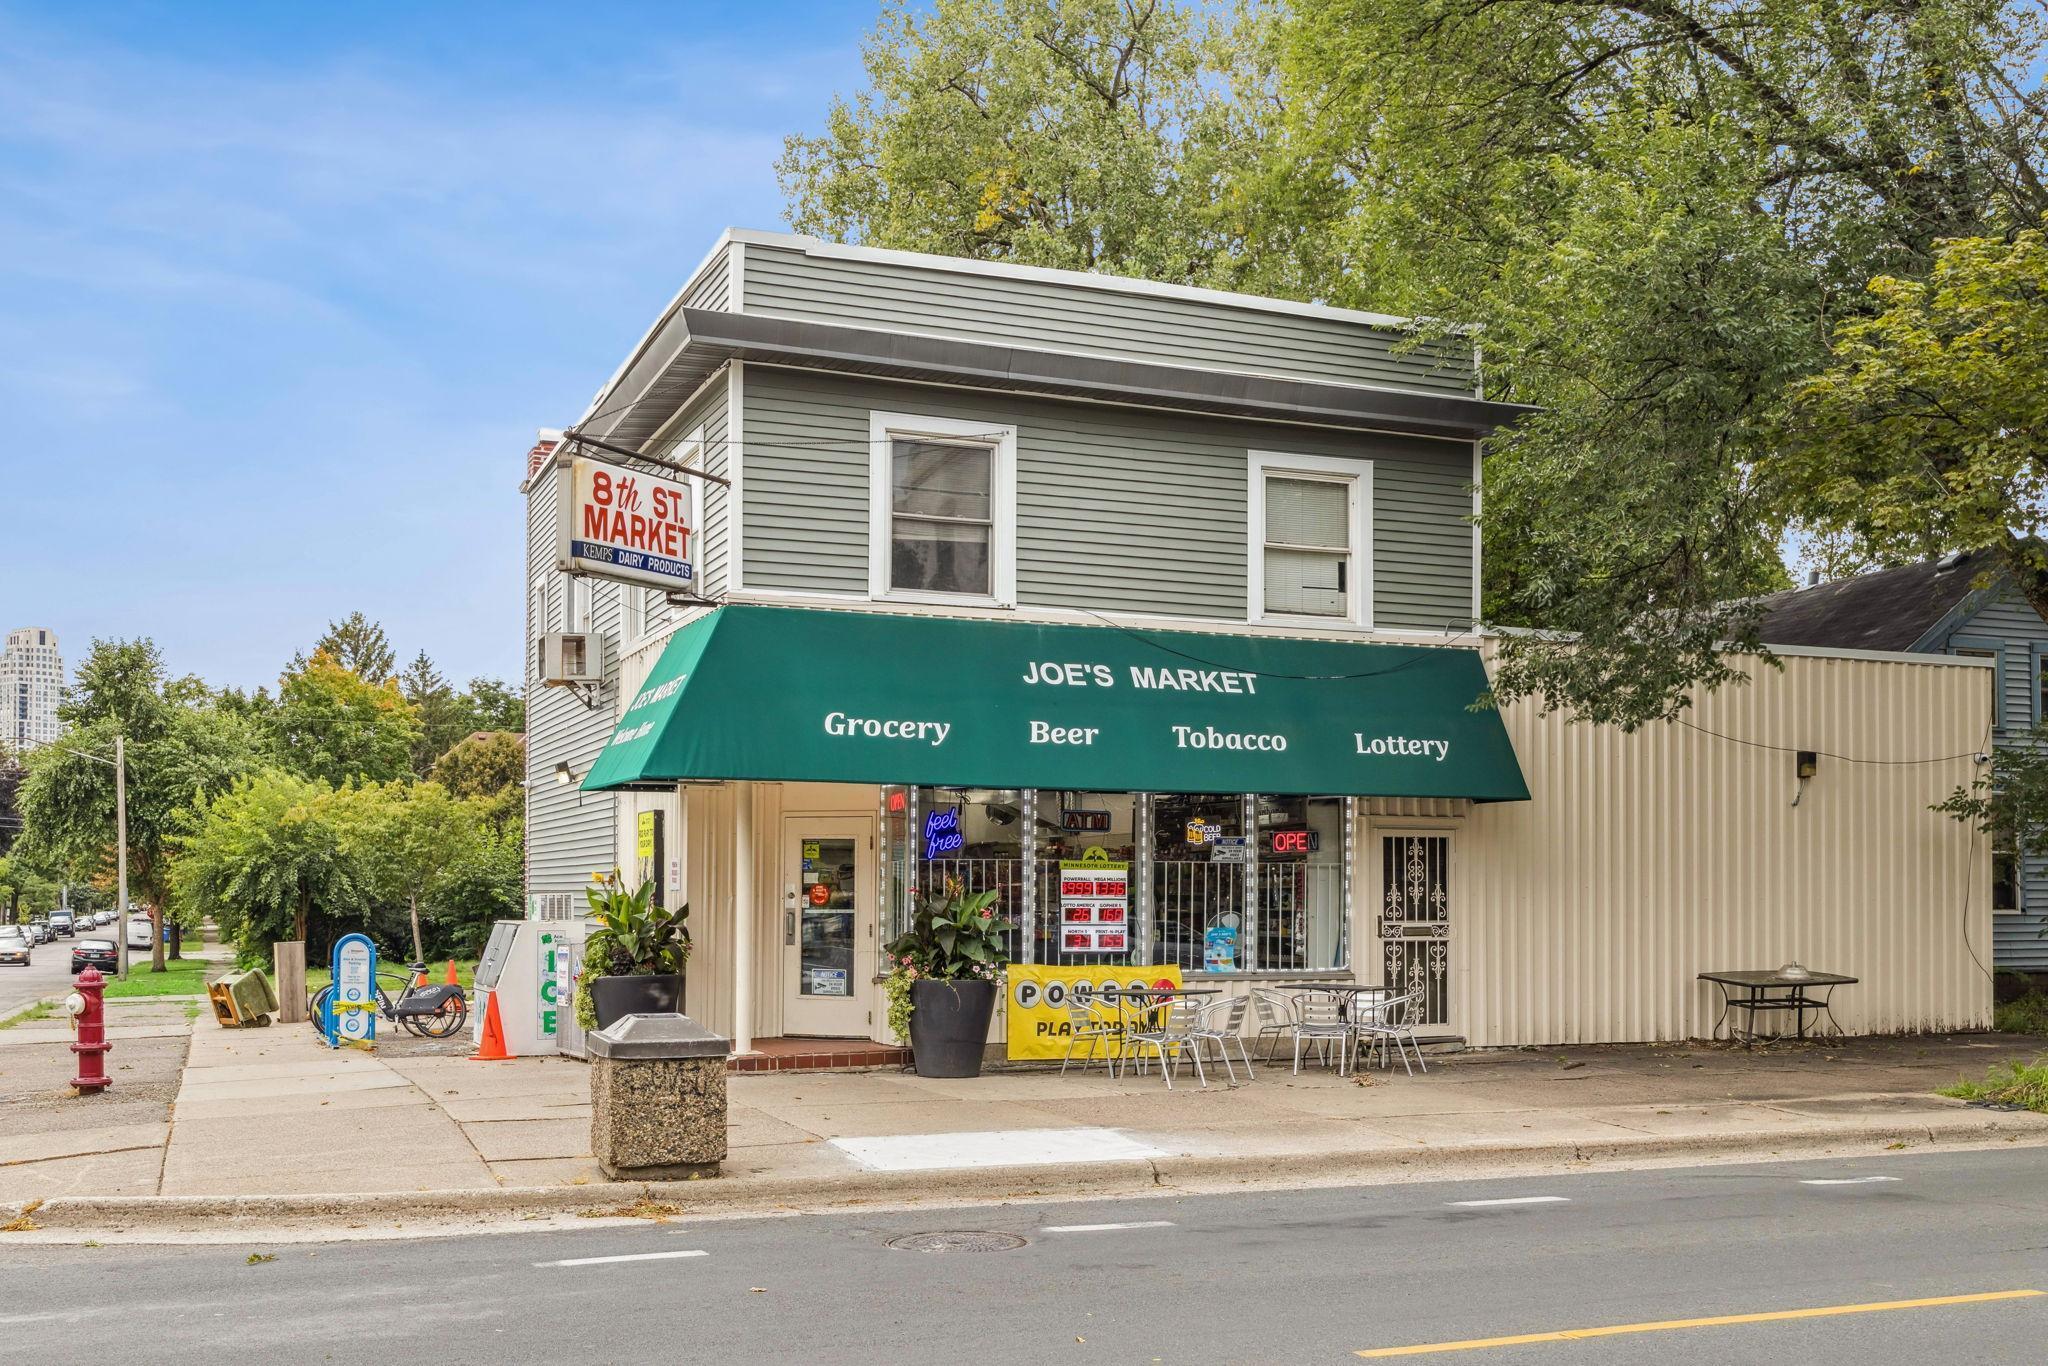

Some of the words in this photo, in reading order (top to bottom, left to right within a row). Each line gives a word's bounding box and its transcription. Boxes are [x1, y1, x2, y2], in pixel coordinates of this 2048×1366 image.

[592, 470, 642, 512] 8th
[652, 486, 685, 525] ST.
[584, 503, 691, 559] MARKET
[583, 543, 613, 562] KEMPS
[618, 551, 647, 568] DAIRY
[648, 557, 690, 578] PRODUCTS
[1022, 662, 1114, 687] JOE'S
[1129, 666, 1257, 695] MARKET
[824, 712, 950, 746] Grocery
[1029, 721, 1098, 745] Beer
[1172, 725, 1287, 751] Tobacco
[1354, 733, 1449, 762] Lottery
[925, 808, 957, 838] feel
[1066, 813, 1106, 829] ATM
[1203, 825, 1221, 833] COLD
[928, 834, 962, 859] free
[1275, 833, 1318, 850] OPEN
